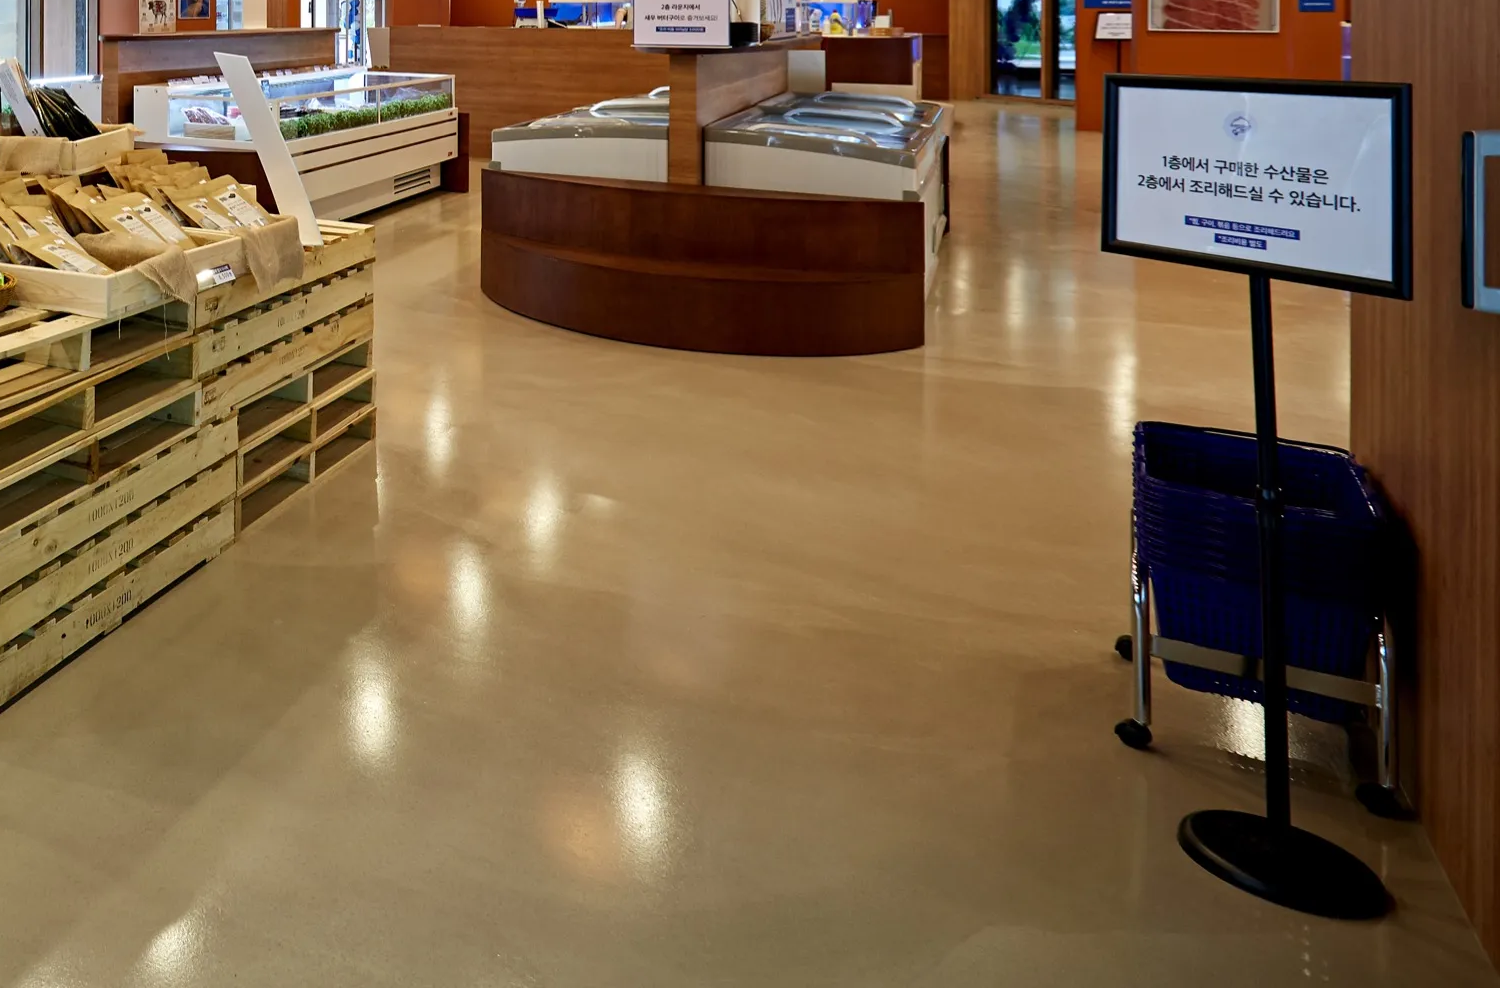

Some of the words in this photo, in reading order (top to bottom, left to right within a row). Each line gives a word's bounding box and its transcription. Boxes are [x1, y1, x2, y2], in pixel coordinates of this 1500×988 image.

[1162, 155, 1210, 174] 1층에서
[1213, 159, 1260, 179] 구매한
[1263, 163, 1329, 186] 수산물은
[1137, 174, 1186, 194] 2층에서
[1189, 179, 1264, 203] 조리해드실
[1268, 186, 1284, 205] 수
[1289, 189, 1361, 213] 있습니다.
